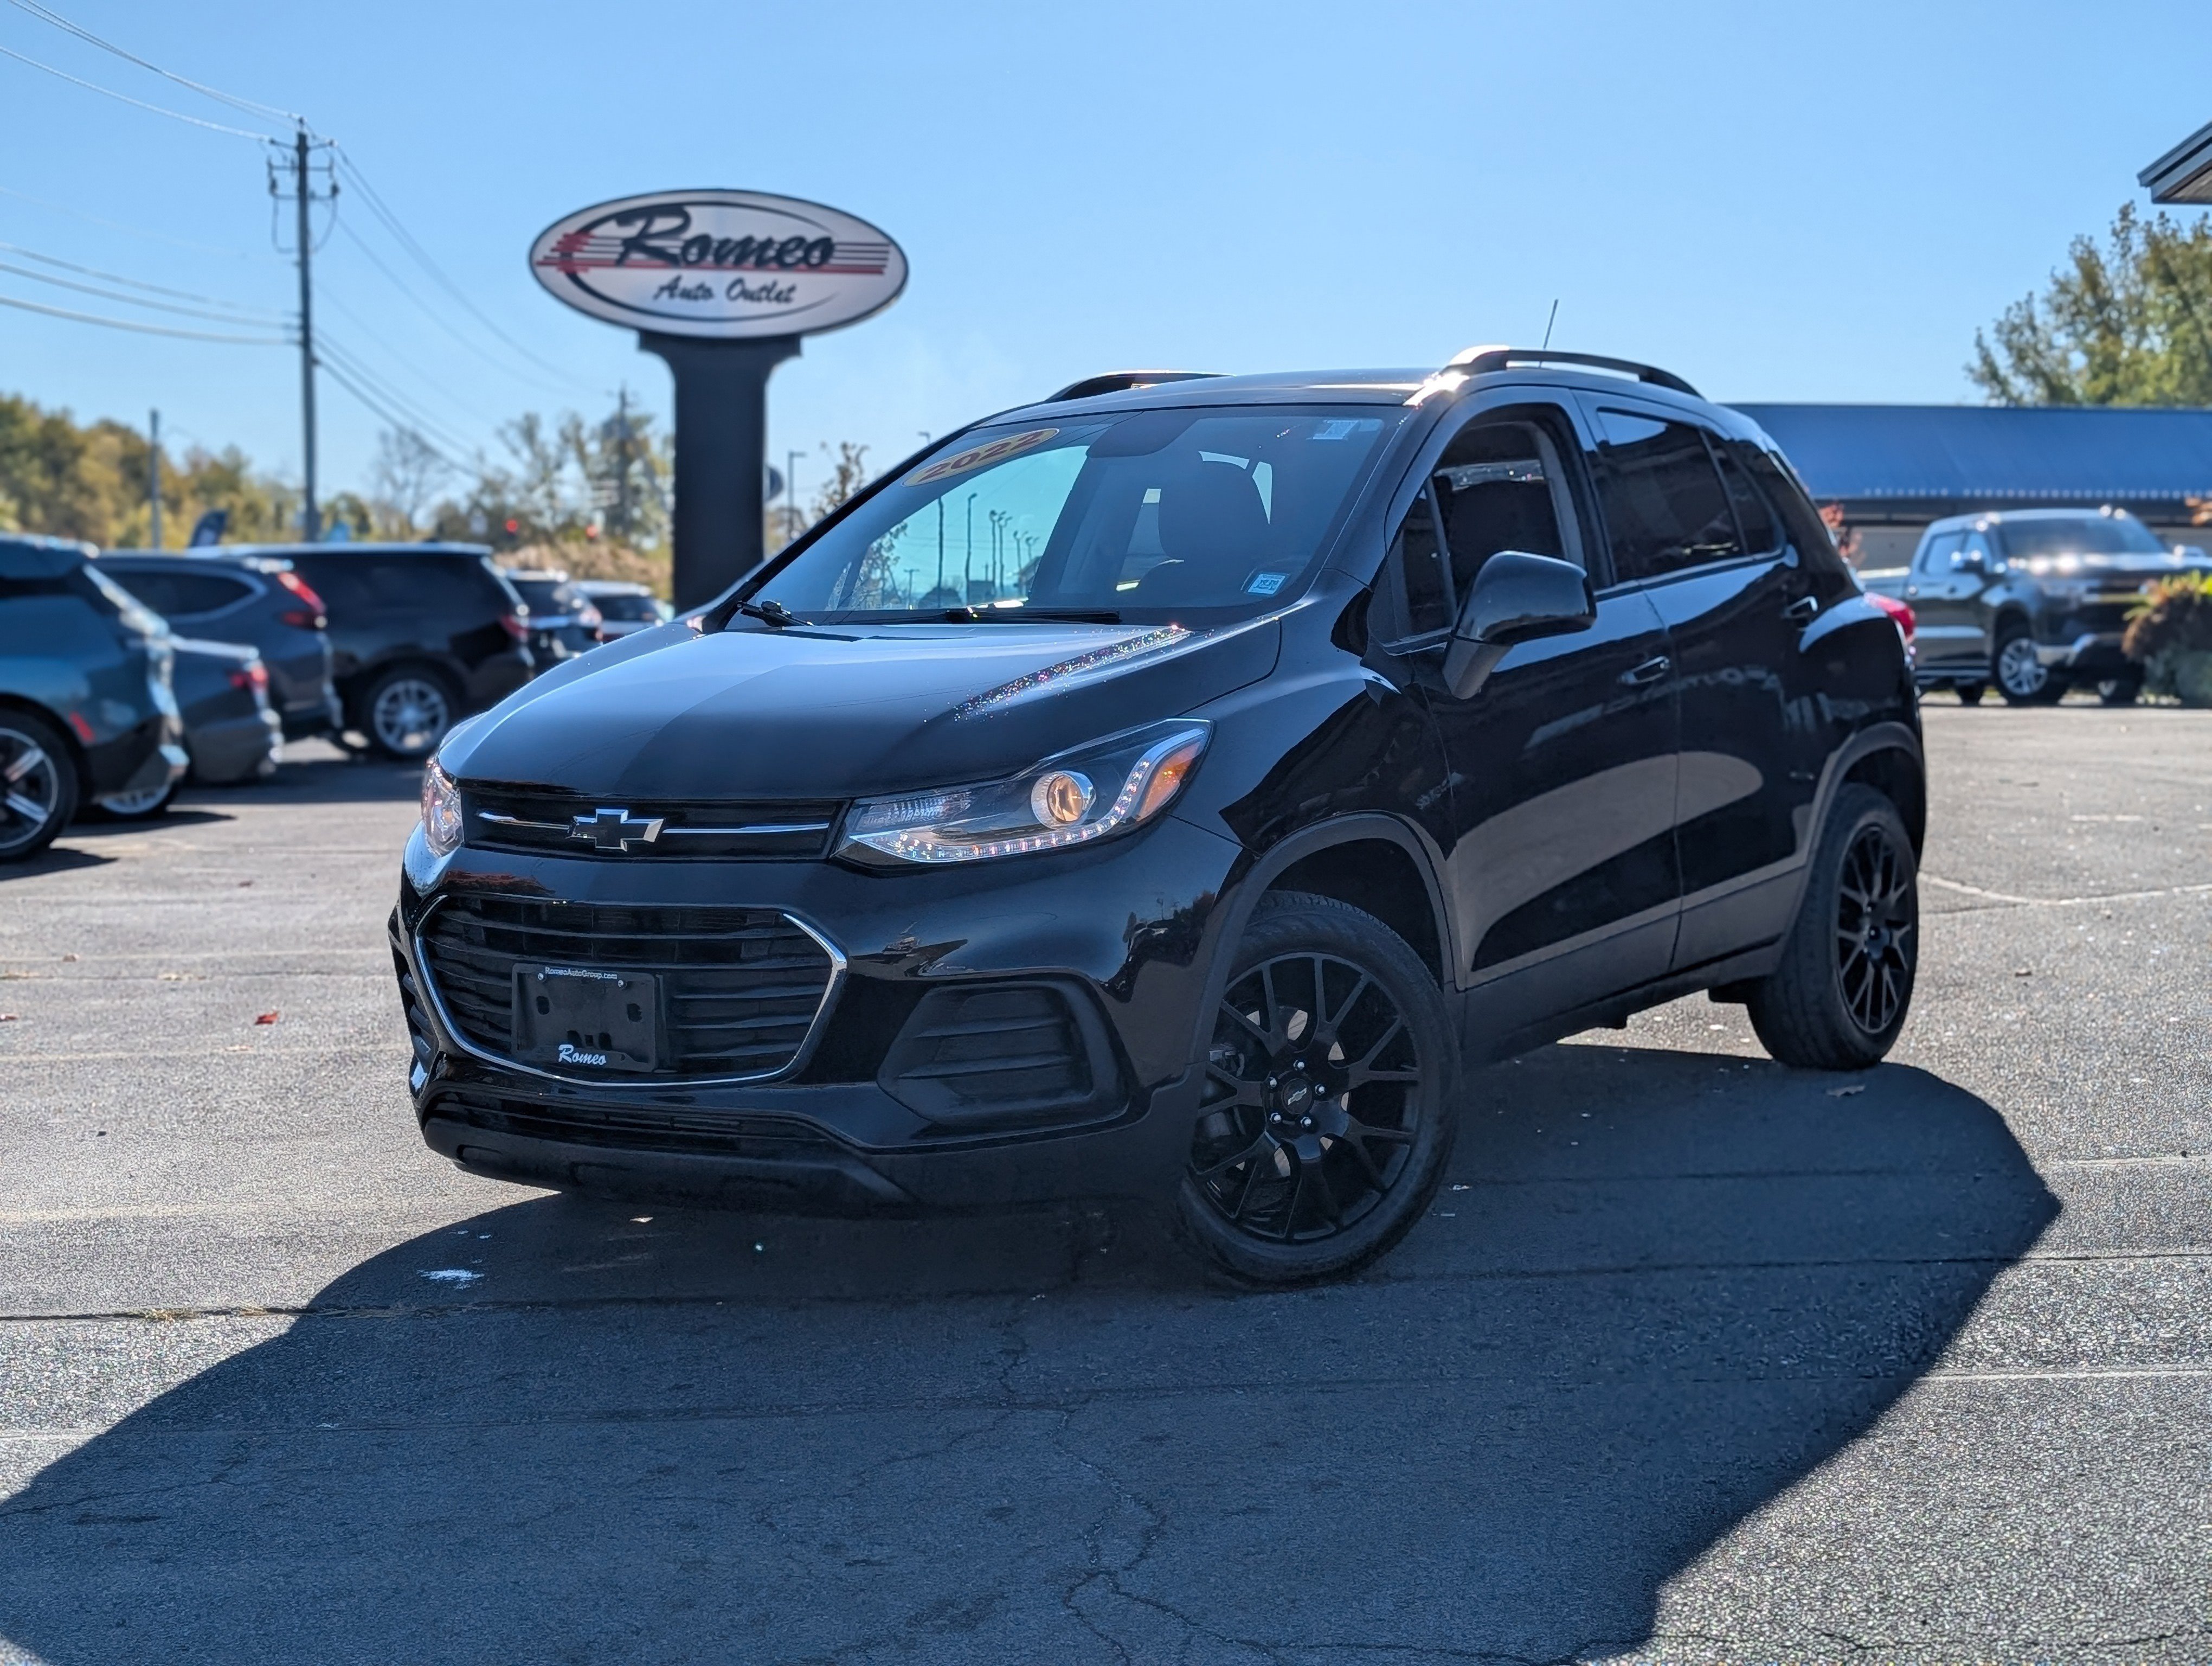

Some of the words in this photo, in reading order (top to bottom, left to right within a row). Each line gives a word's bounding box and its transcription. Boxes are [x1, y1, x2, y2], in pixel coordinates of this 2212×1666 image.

[614, 203, 835, 268] Romeo
[653, 274, 715, 302] Auto
[725, 277, 798, 304] Outlet
[917, 431, 1044, 482] 2022
[545, 966, 618, 980] RomeoAutoGroup.com
[558, 1044, 607, 1066] Romeo
